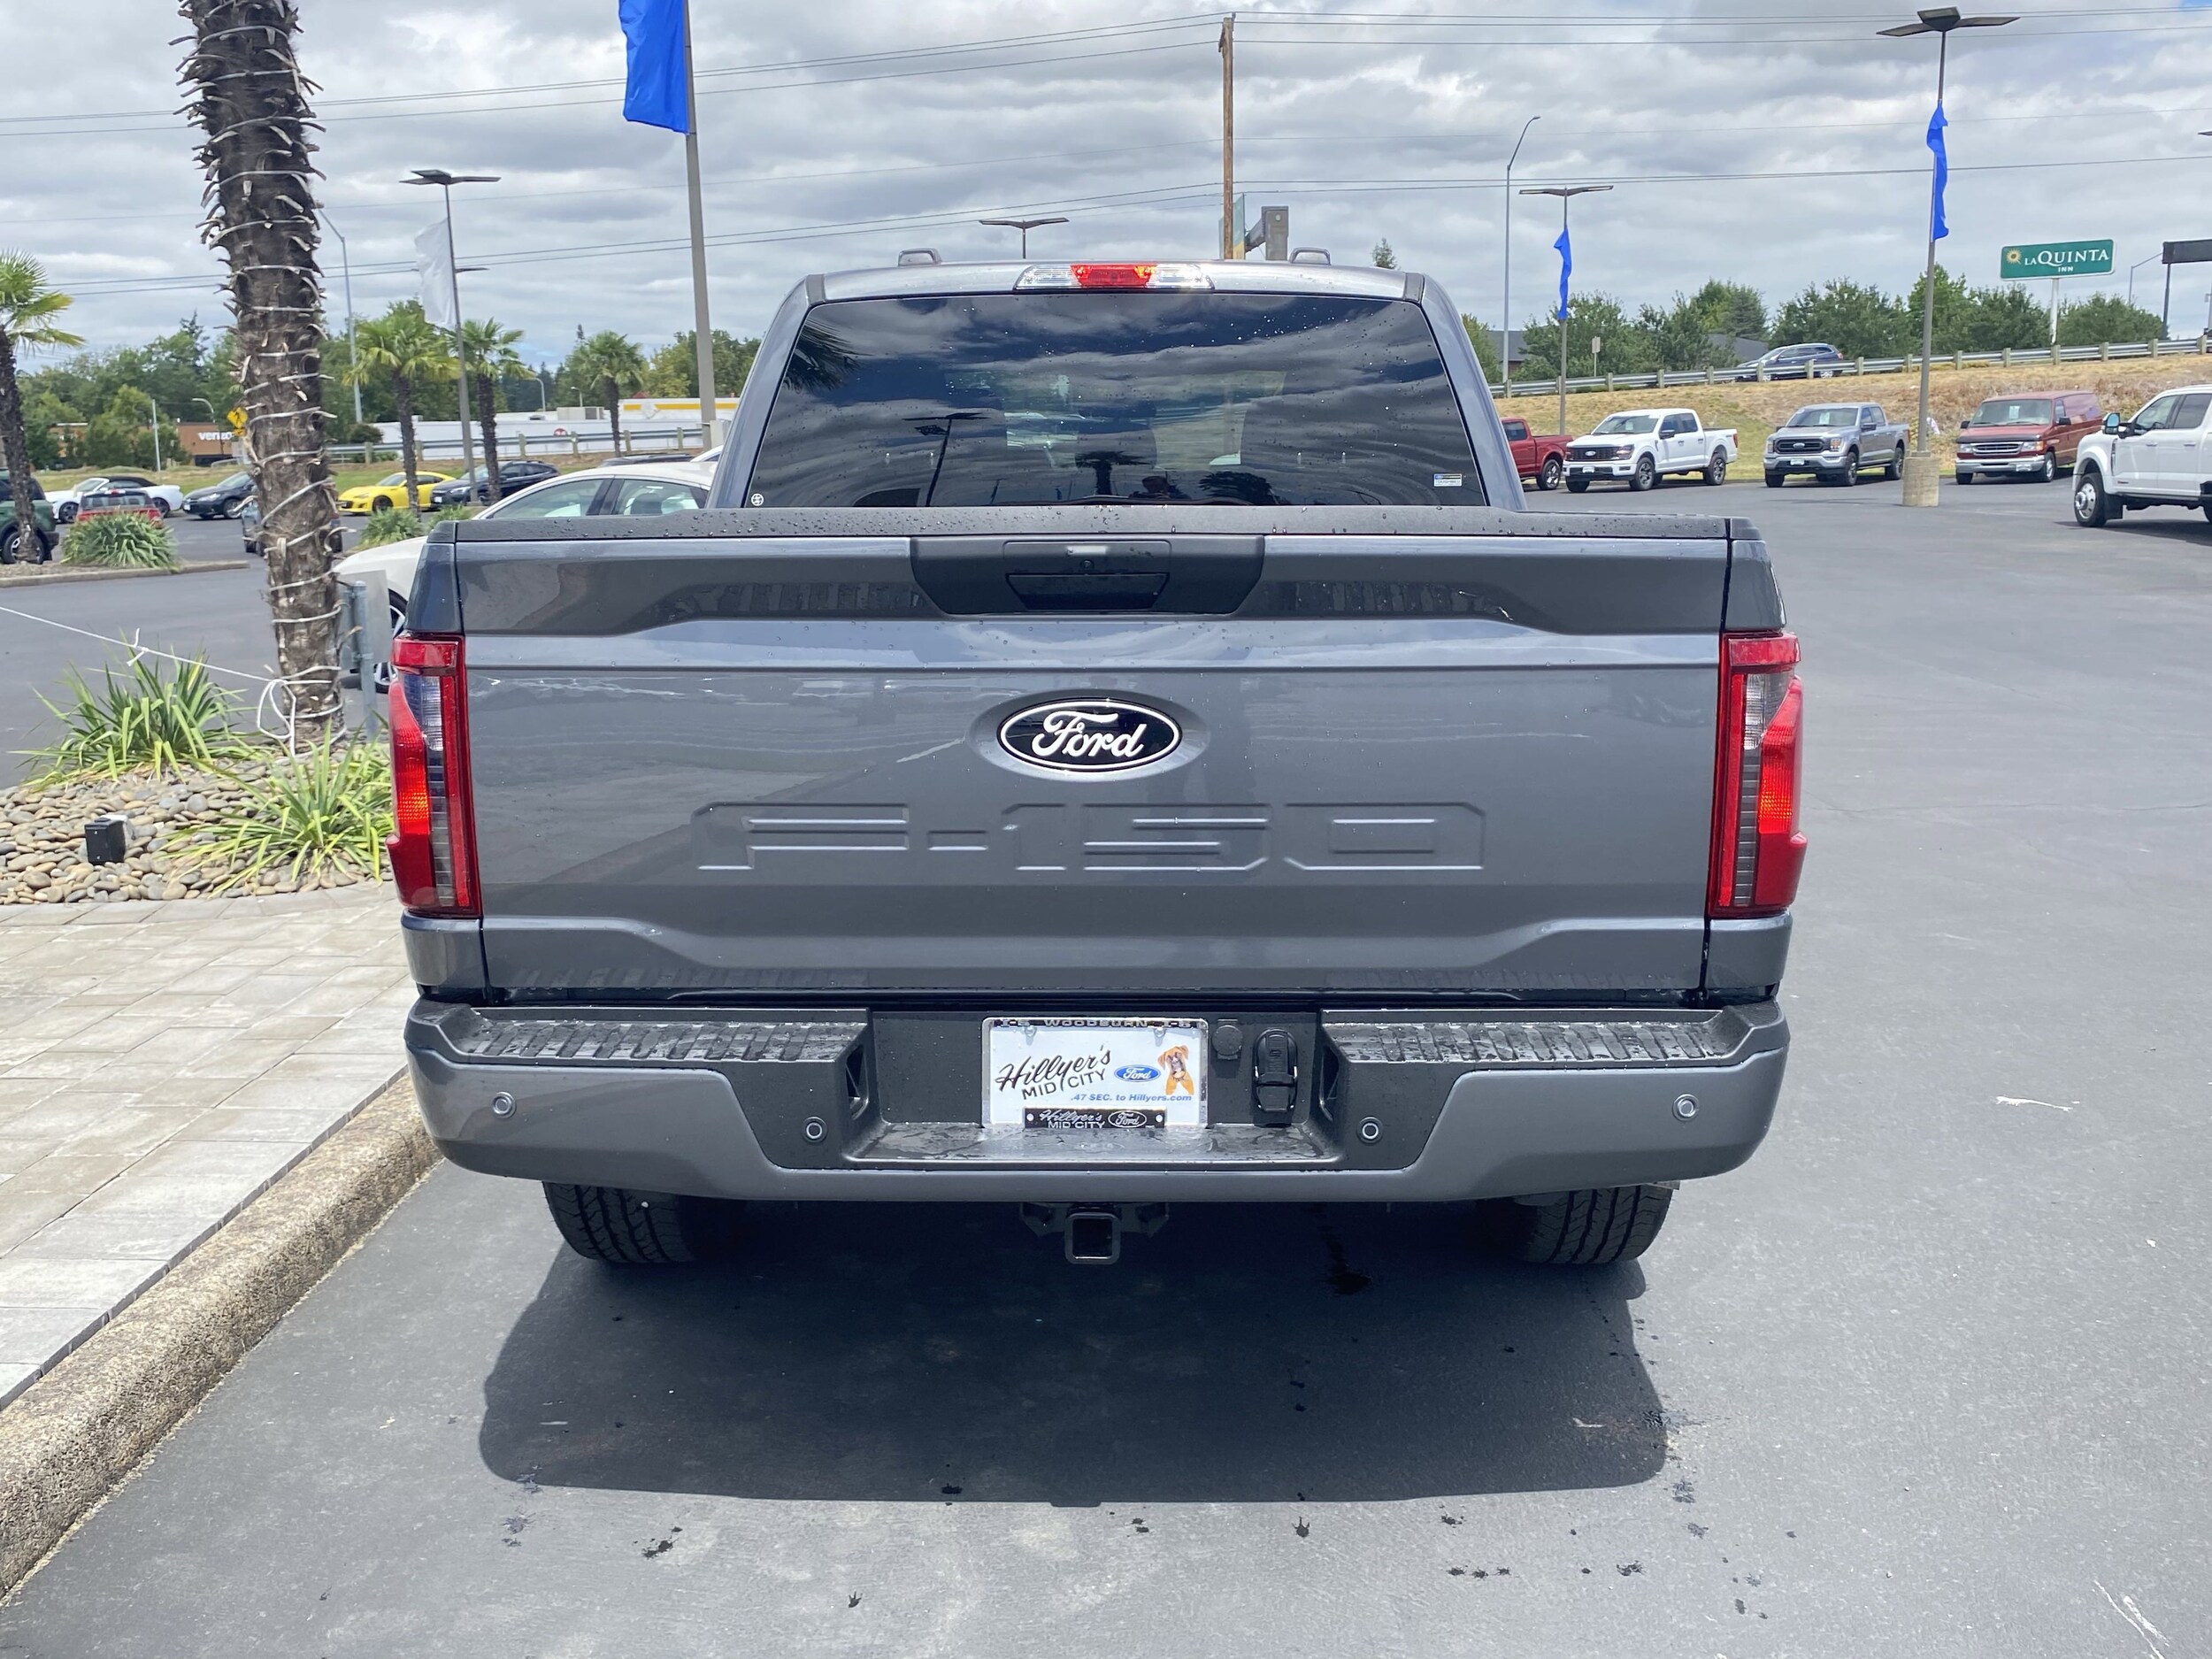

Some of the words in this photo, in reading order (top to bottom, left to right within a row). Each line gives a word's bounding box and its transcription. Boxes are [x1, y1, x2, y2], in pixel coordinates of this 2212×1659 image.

[2038, 249, 2110, 266] QUINTA
[198, 431, 235, 441] verizo
[1032, 710, 1147, 757] Ford
[693, 803, 1486, 872] F-150
[995, 1044, 1110, 1092] Hillyer's
[1022, 1081, 1056, 1100] MID
[1067, 1068, 1106, 1088] CITY
[1129, 1094, 1192, 1103] Hillyers.com
[1039, 1109, 1102, 1124] Hillyer's
